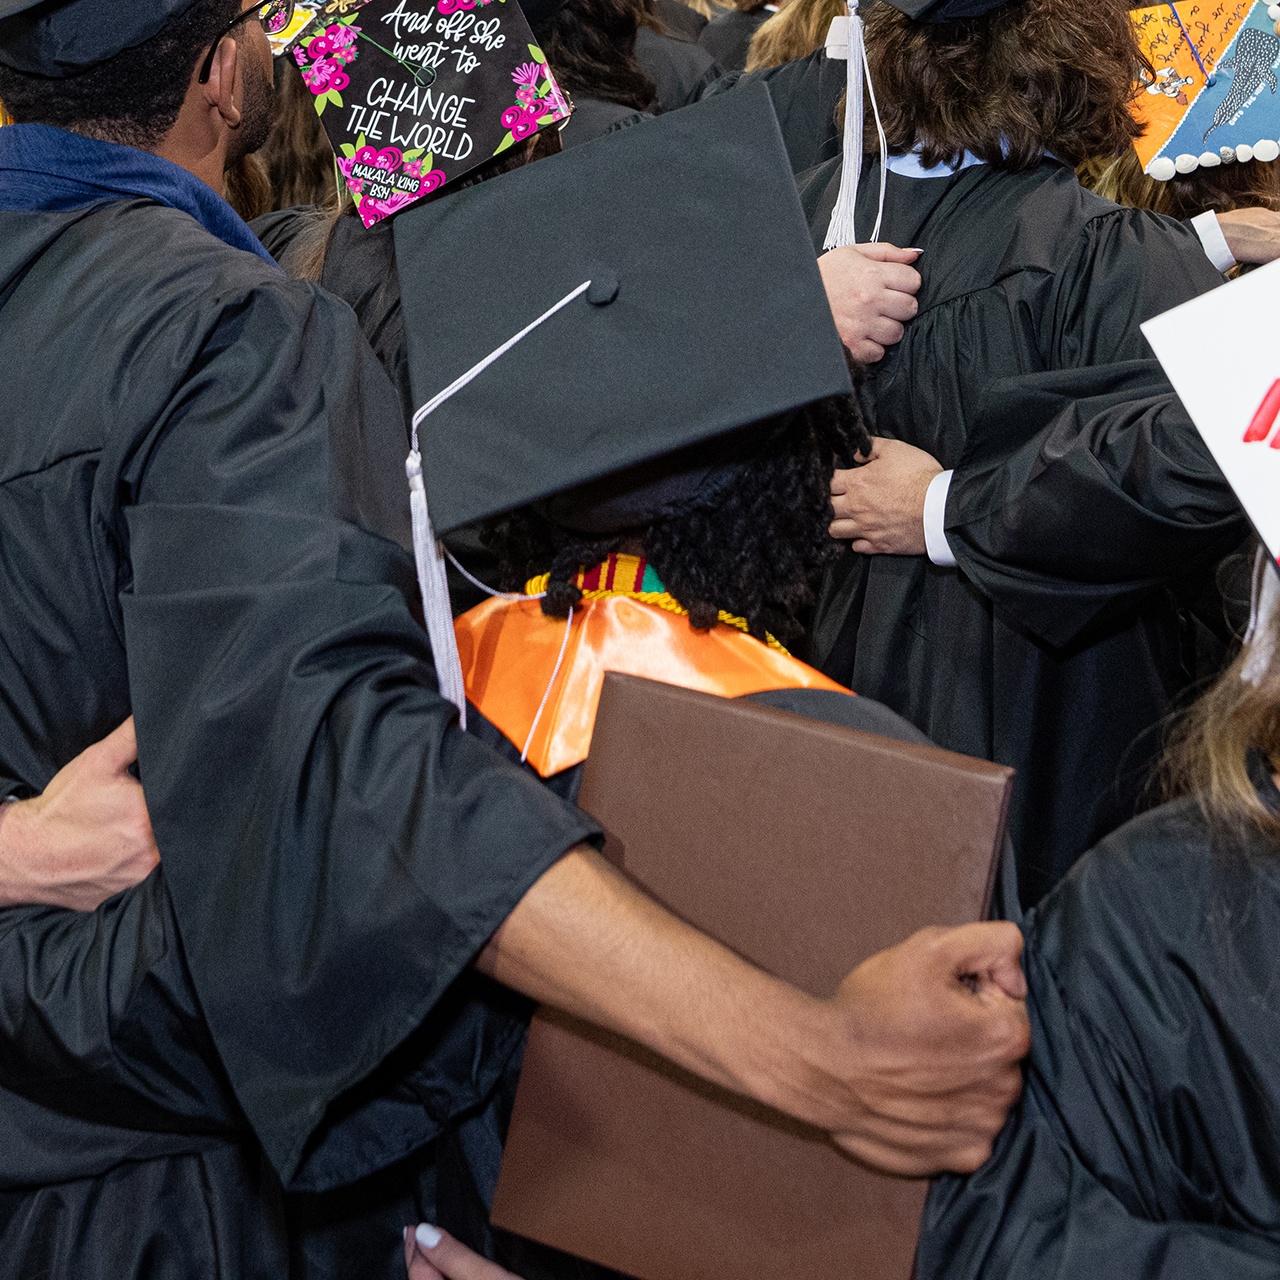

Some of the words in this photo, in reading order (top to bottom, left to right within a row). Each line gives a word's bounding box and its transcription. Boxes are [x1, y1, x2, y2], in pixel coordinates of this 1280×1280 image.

[435, 10, 476, 42] off
[392, 41, 449, 69] went
[451, 45, 481, 74] to
[366, 77, 475, 128] CHANGE
[346, 104, 391, 140] THE
[389, 115, 473, 161] WORLD
[369, 183, 391, 200] BSN
[396, 176, 420, 193] KING
